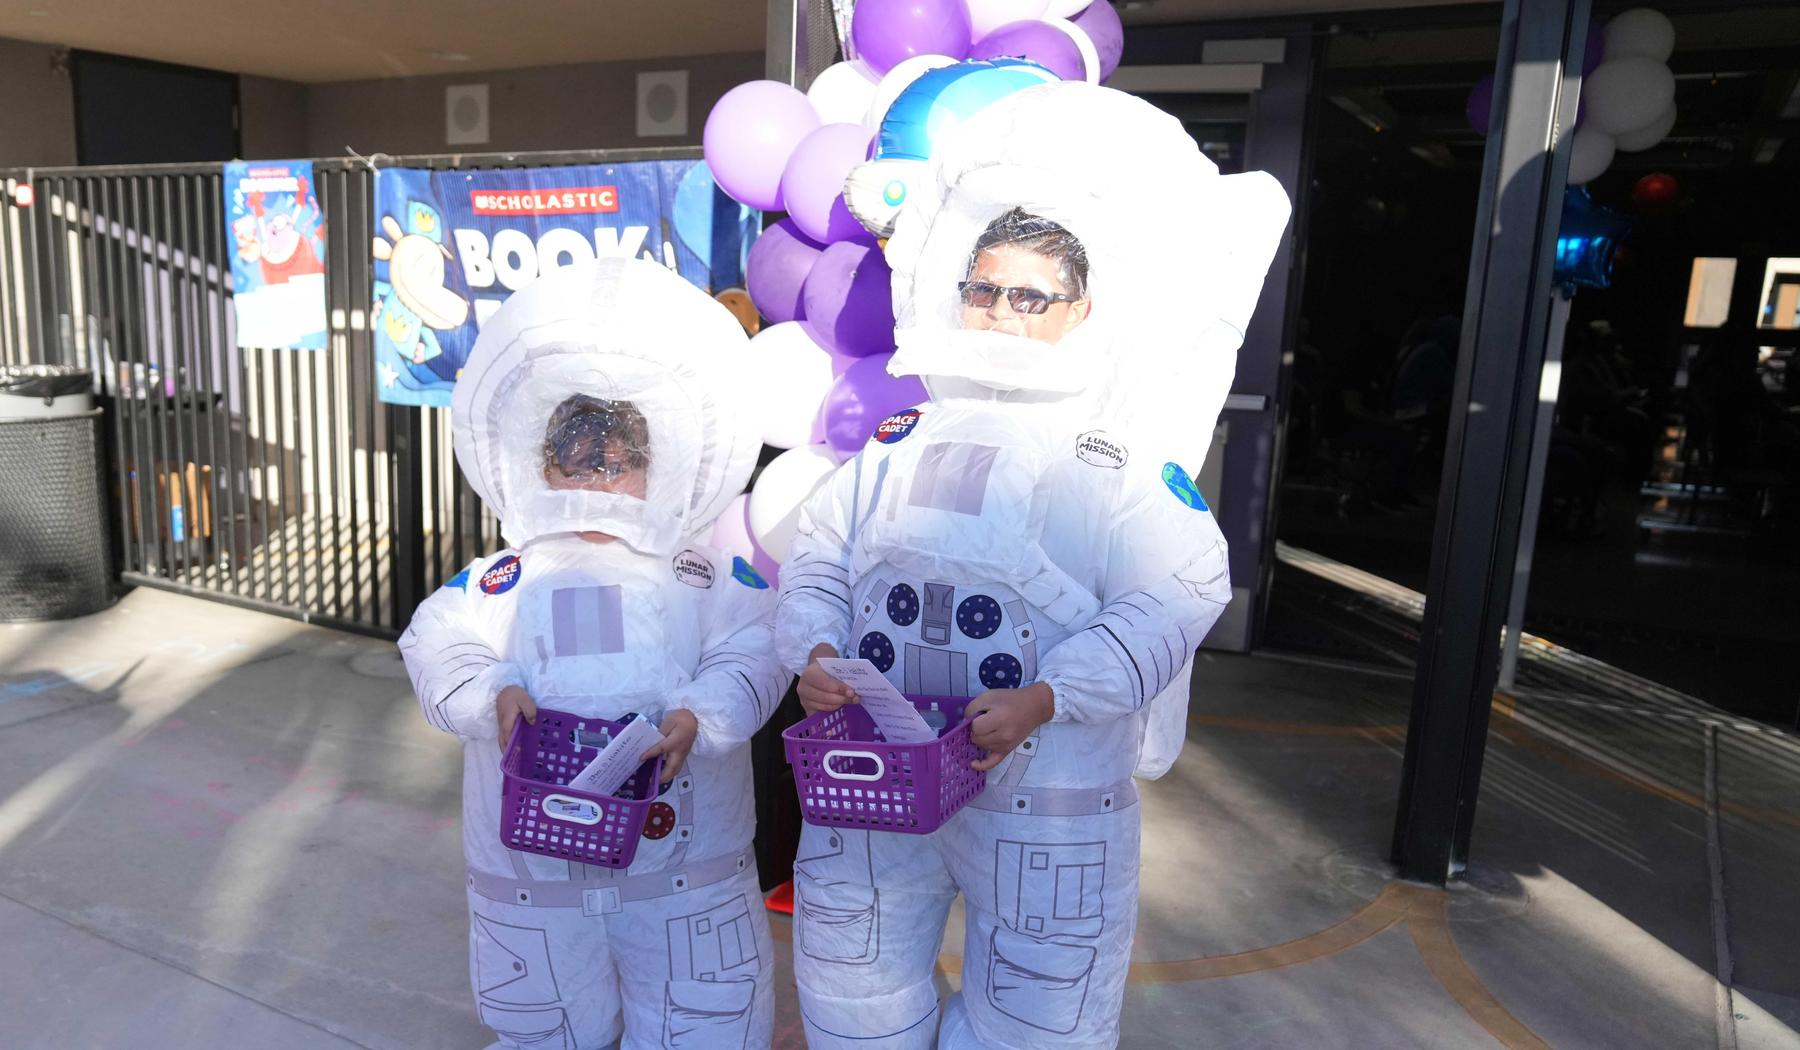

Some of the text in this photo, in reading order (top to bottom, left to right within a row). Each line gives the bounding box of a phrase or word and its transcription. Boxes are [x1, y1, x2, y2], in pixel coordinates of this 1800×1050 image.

[488, 191, 613, 210] SCHOLASTIC
[878, 424, 908, 433] CADET
[1087, 436, 1121, 454] LUNAR
[1079, 443, 1123, 464] MISSION
[484, 562, 517, 580] SPACE
[676, 566, 711, 581] MISSION
[680, 559, 708, 572] LUNAR
[486, 573, 514, 587] CADET
